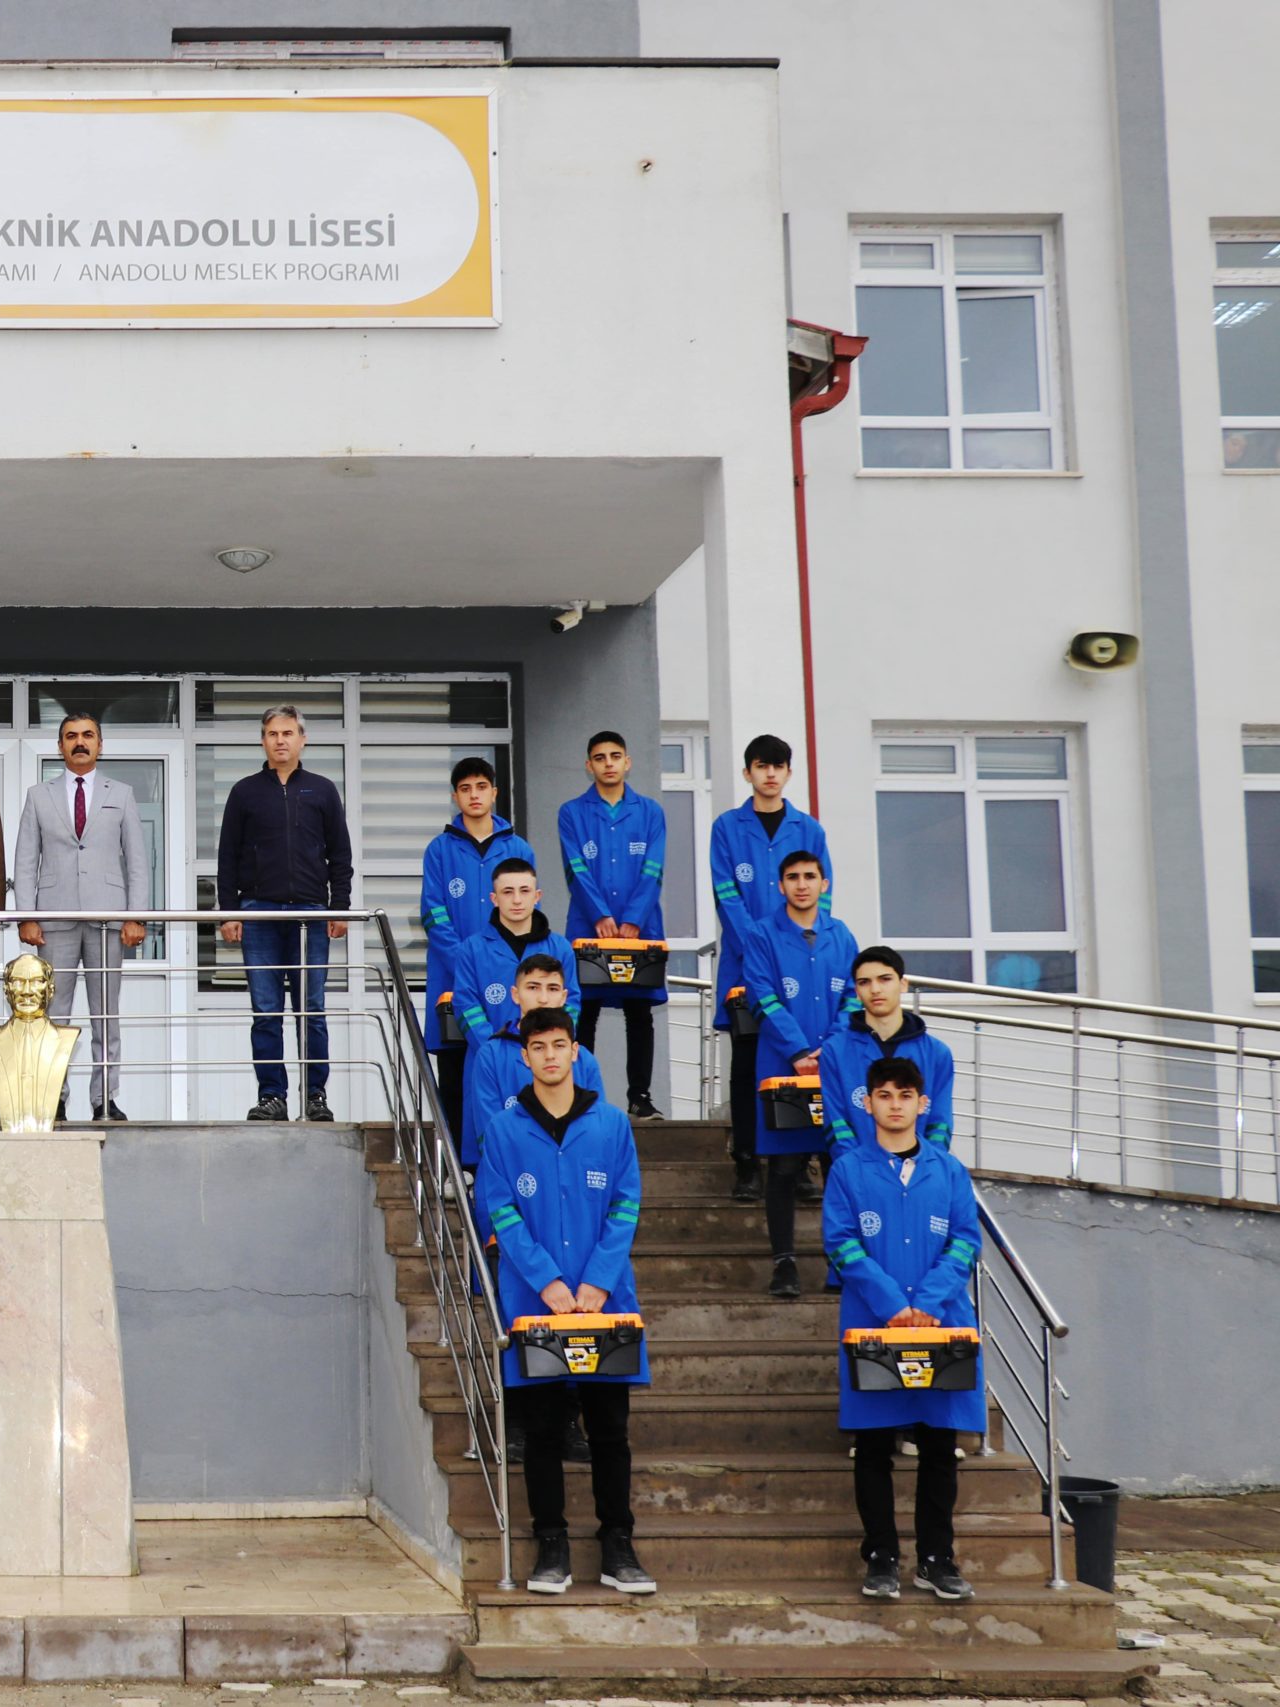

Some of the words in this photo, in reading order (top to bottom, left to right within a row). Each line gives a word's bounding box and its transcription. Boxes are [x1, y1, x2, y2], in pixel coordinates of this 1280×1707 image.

[90, 218, 276, 248] ANADOLU
[288, 212, 396, 247] LİSESİ
[78, 263, 187, 282] ANADOLU
[194, 262, 278, 281] MESLEK
[284, 262, 400, 281] PROGRAMI
